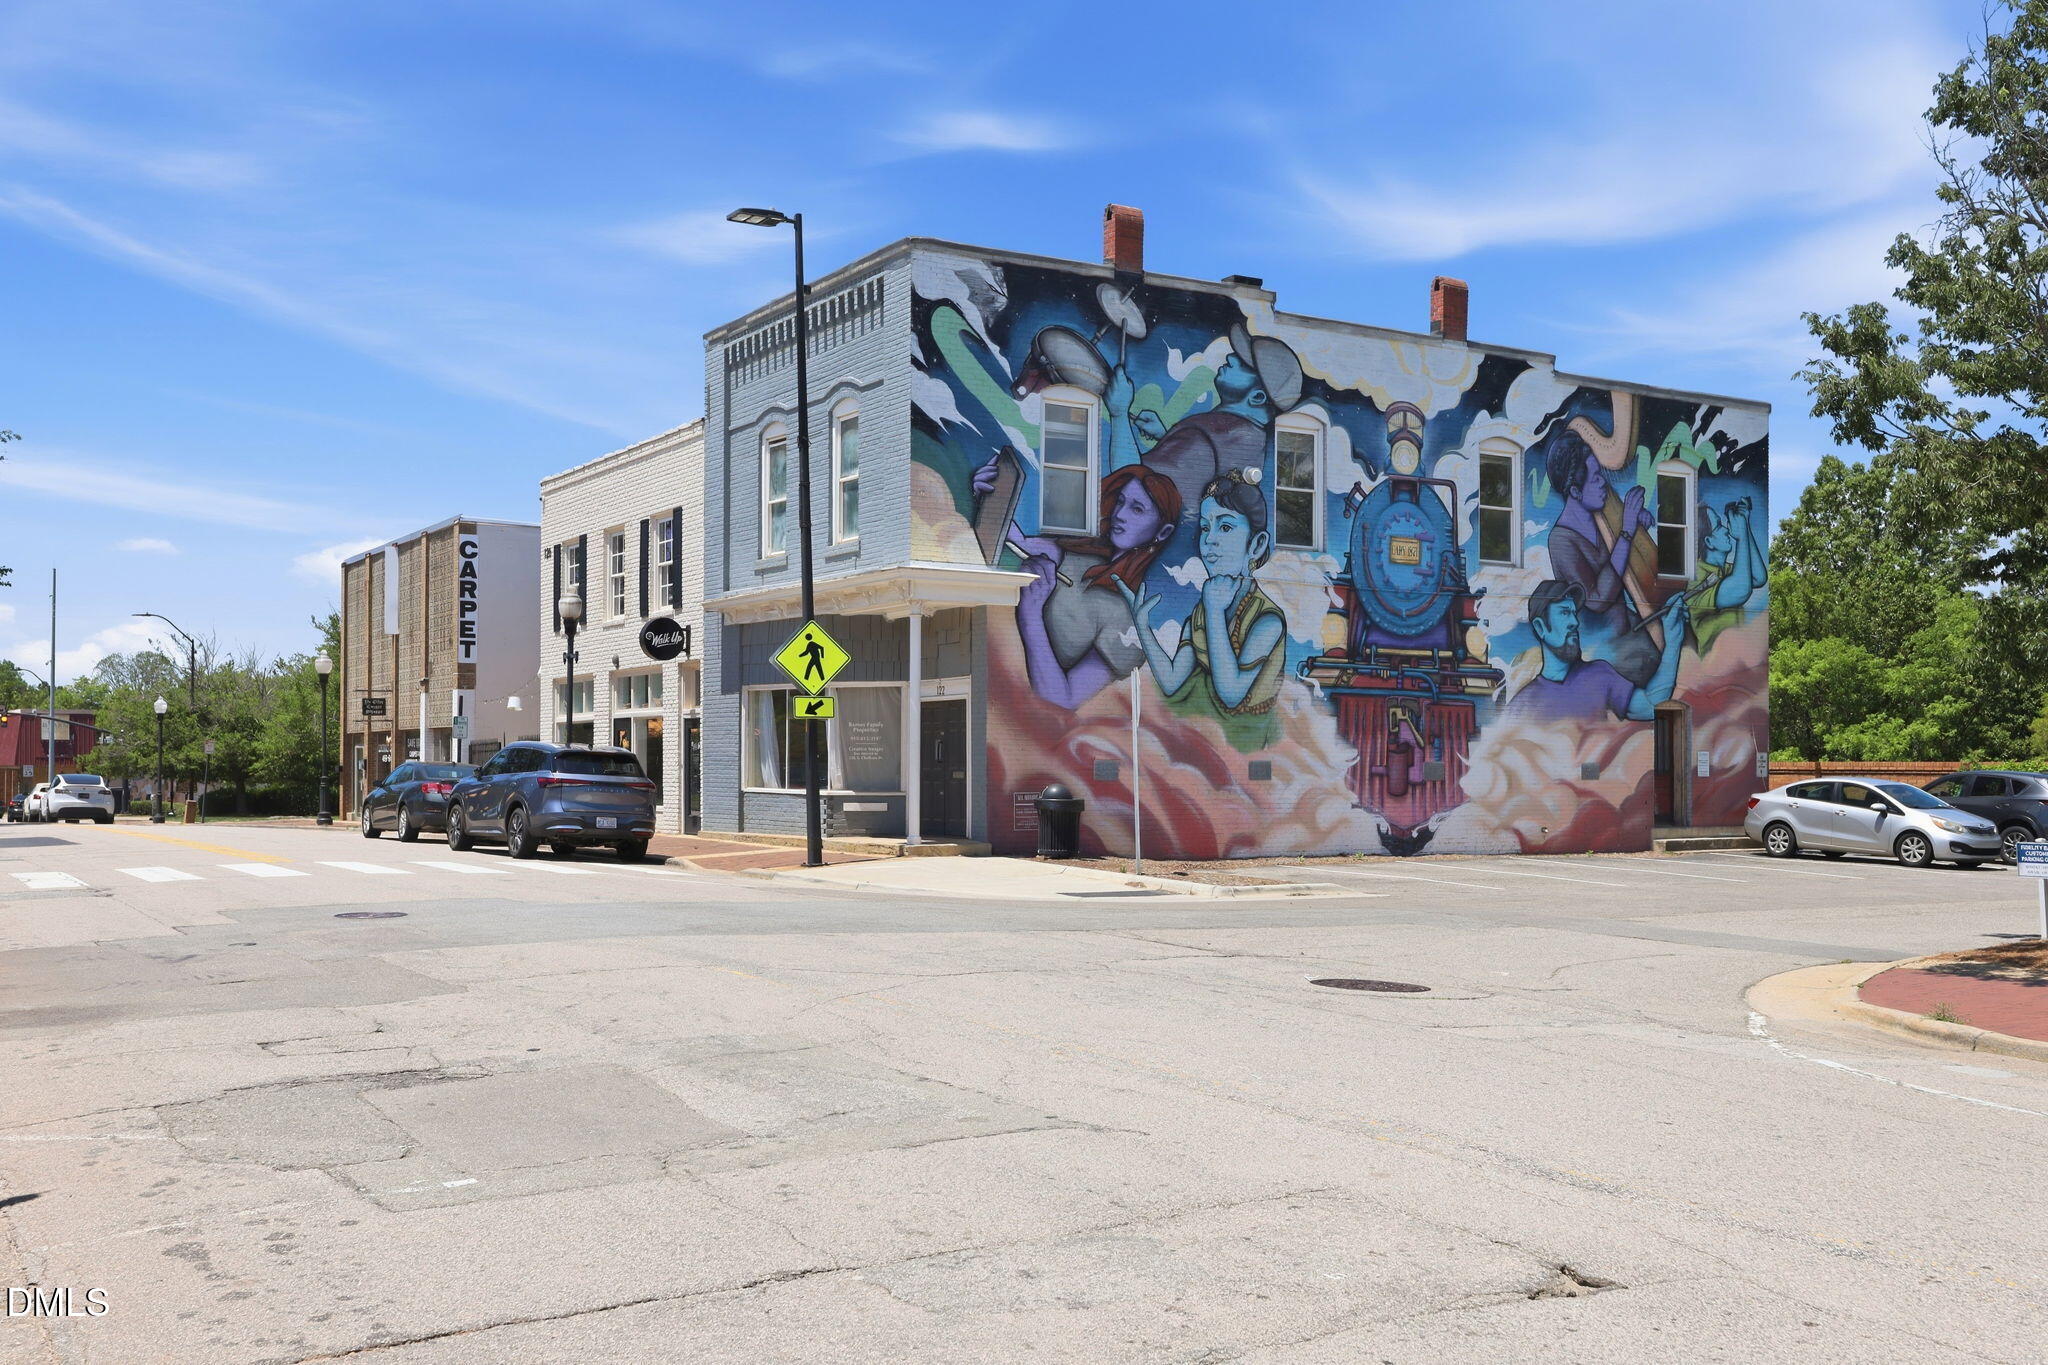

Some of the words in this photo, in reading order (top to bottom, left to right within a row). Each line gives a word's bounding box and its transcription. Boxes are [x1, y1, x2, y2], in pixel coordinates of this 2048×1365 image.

[459, 540, 478, 658] CARPET
[645, 631, 670, 647] Walk
[670, 630, 683, 645] Up
[936, 685, 945, 695] 122
